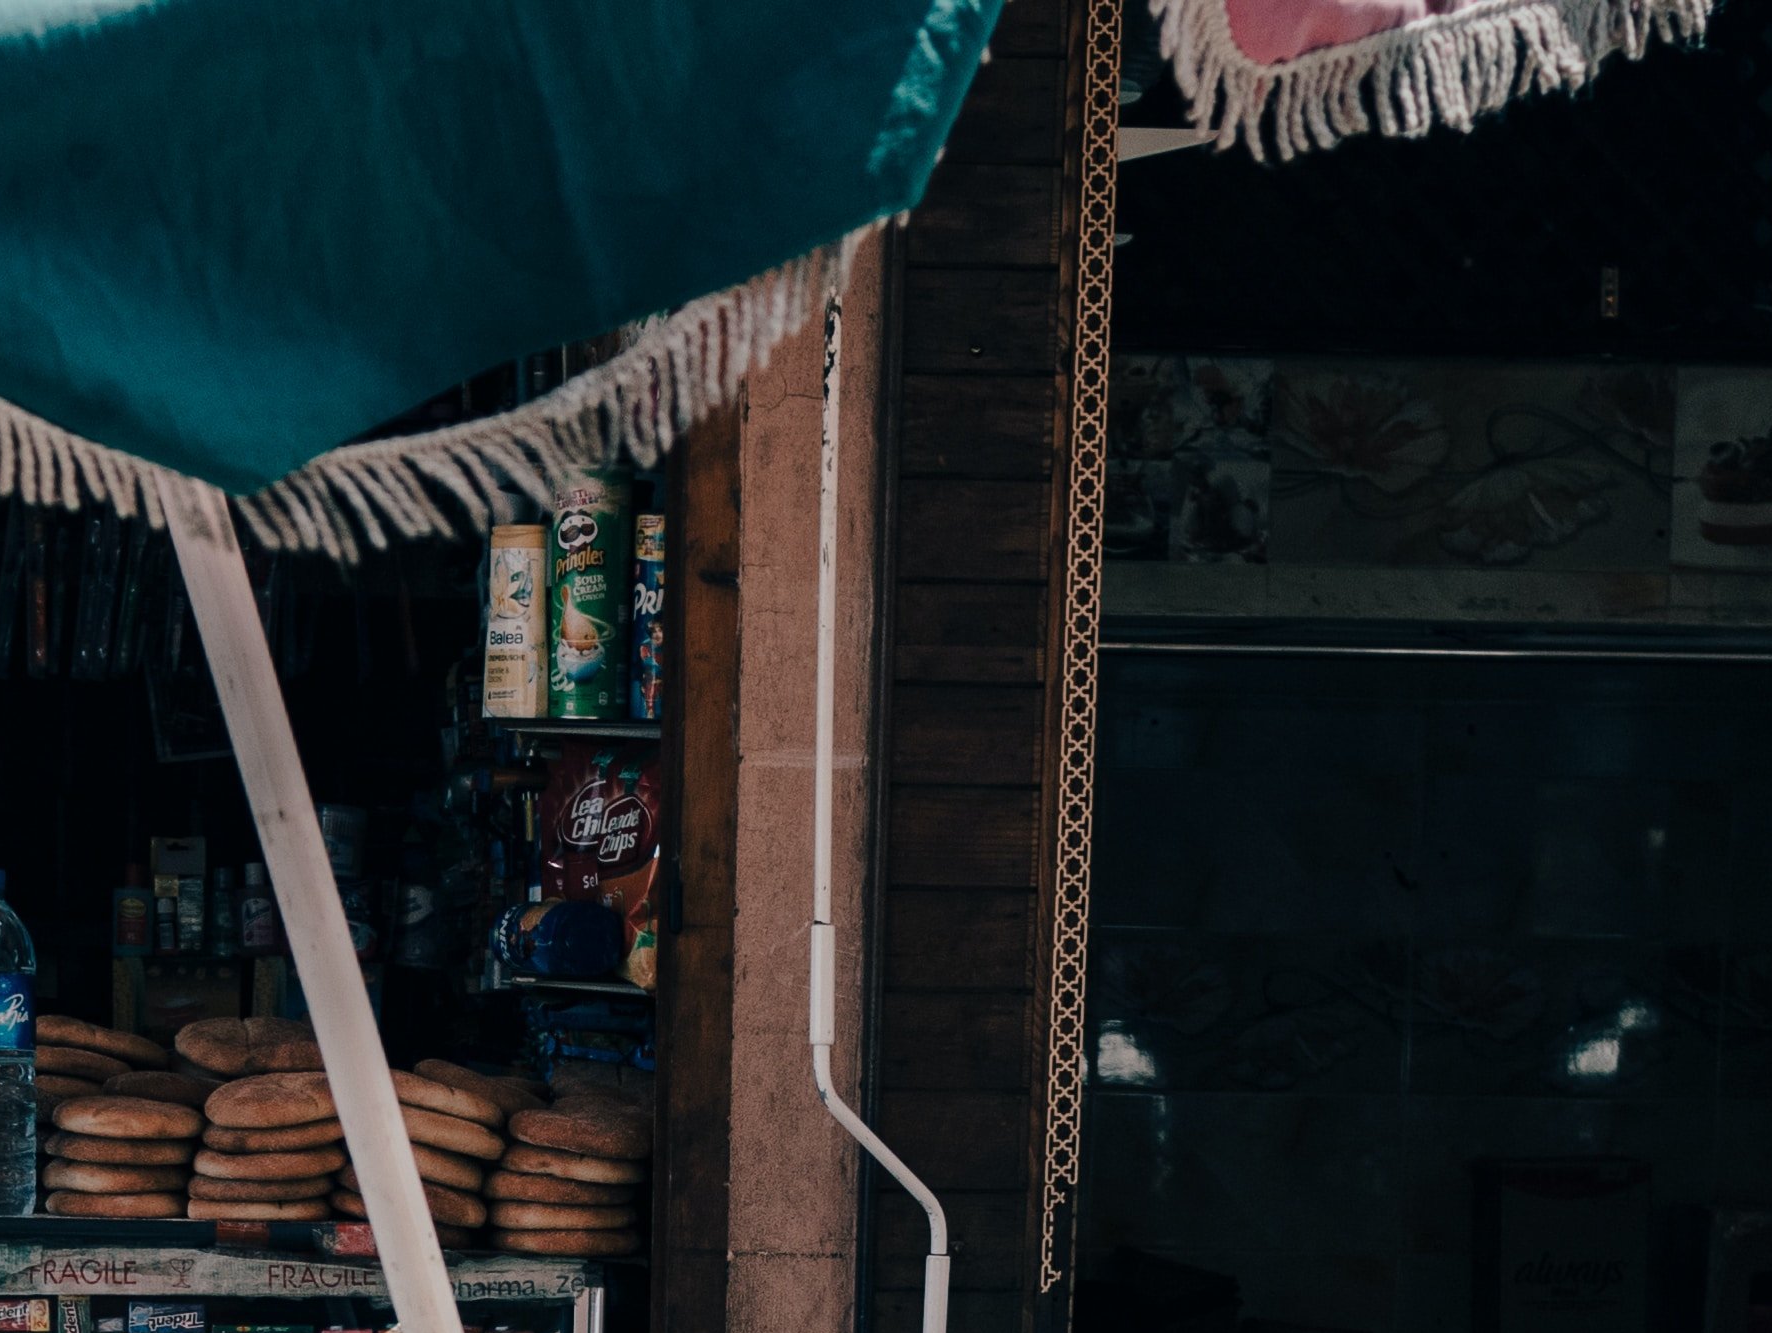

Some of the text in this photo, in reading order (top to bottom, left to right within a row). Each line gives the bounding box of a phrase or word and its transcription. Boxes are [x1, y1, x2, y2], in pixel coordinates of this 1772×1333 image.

[556, 545, 605, 583] Pringles
[574, 575, 604, 585] SOUR
[489, 630, 524, 645] Balea
[599, 831, 638, 857] Chips
[31, 1258, 137, 1286] FRAGILE
[268, 1264, 379, 1290] FRAGILE
[148, 1311, 204, 1331] Trident
